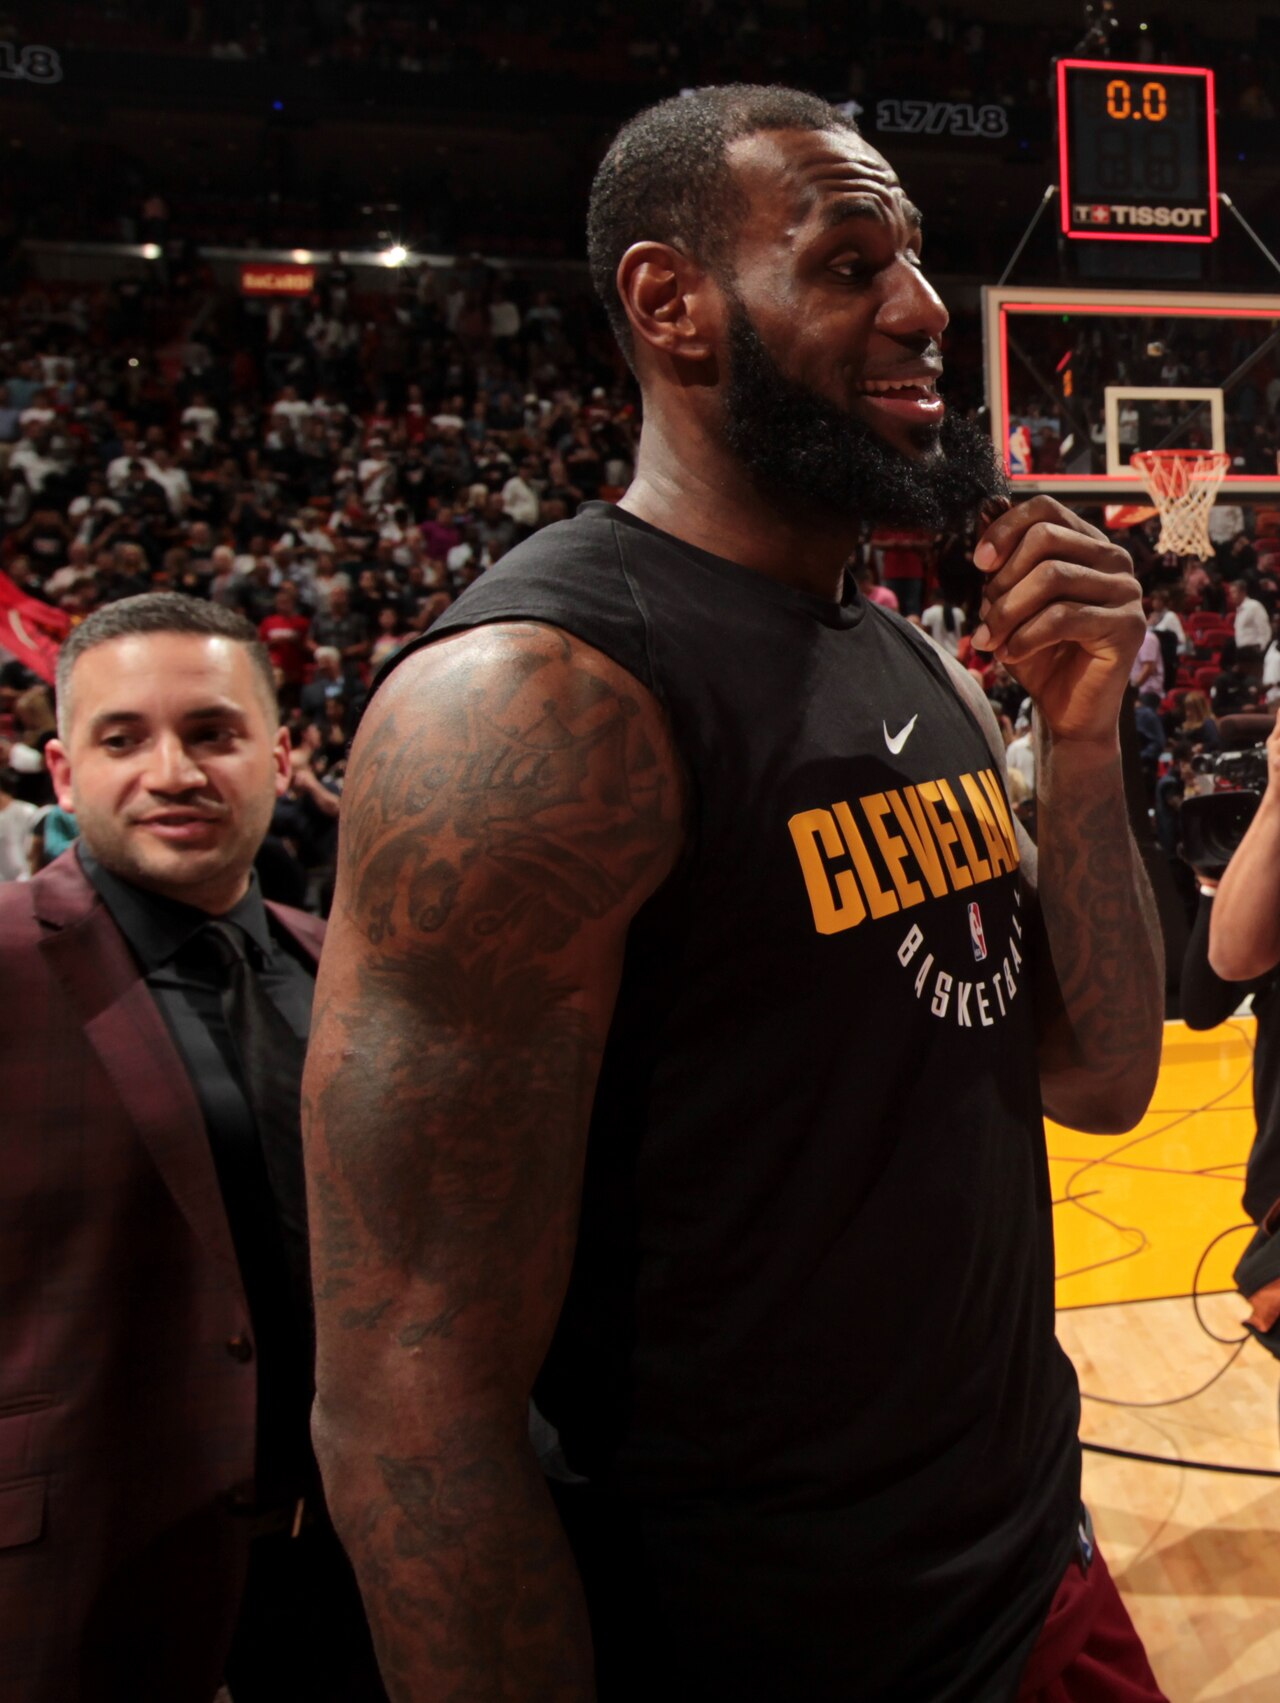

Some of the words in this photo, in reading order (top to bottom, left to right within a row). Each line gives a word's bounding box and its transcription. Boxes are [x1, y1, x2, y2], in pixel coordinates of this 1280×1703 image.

[876, 99, 1009, 138] 17/18
[1106, 79, 1168, 121] 0.0
[1111, 206, 1206, 227] TISSOT
[788, 768, 1020, 936] CLEVELAN
[897, 889, 1022, 1027] BASKETBALL
